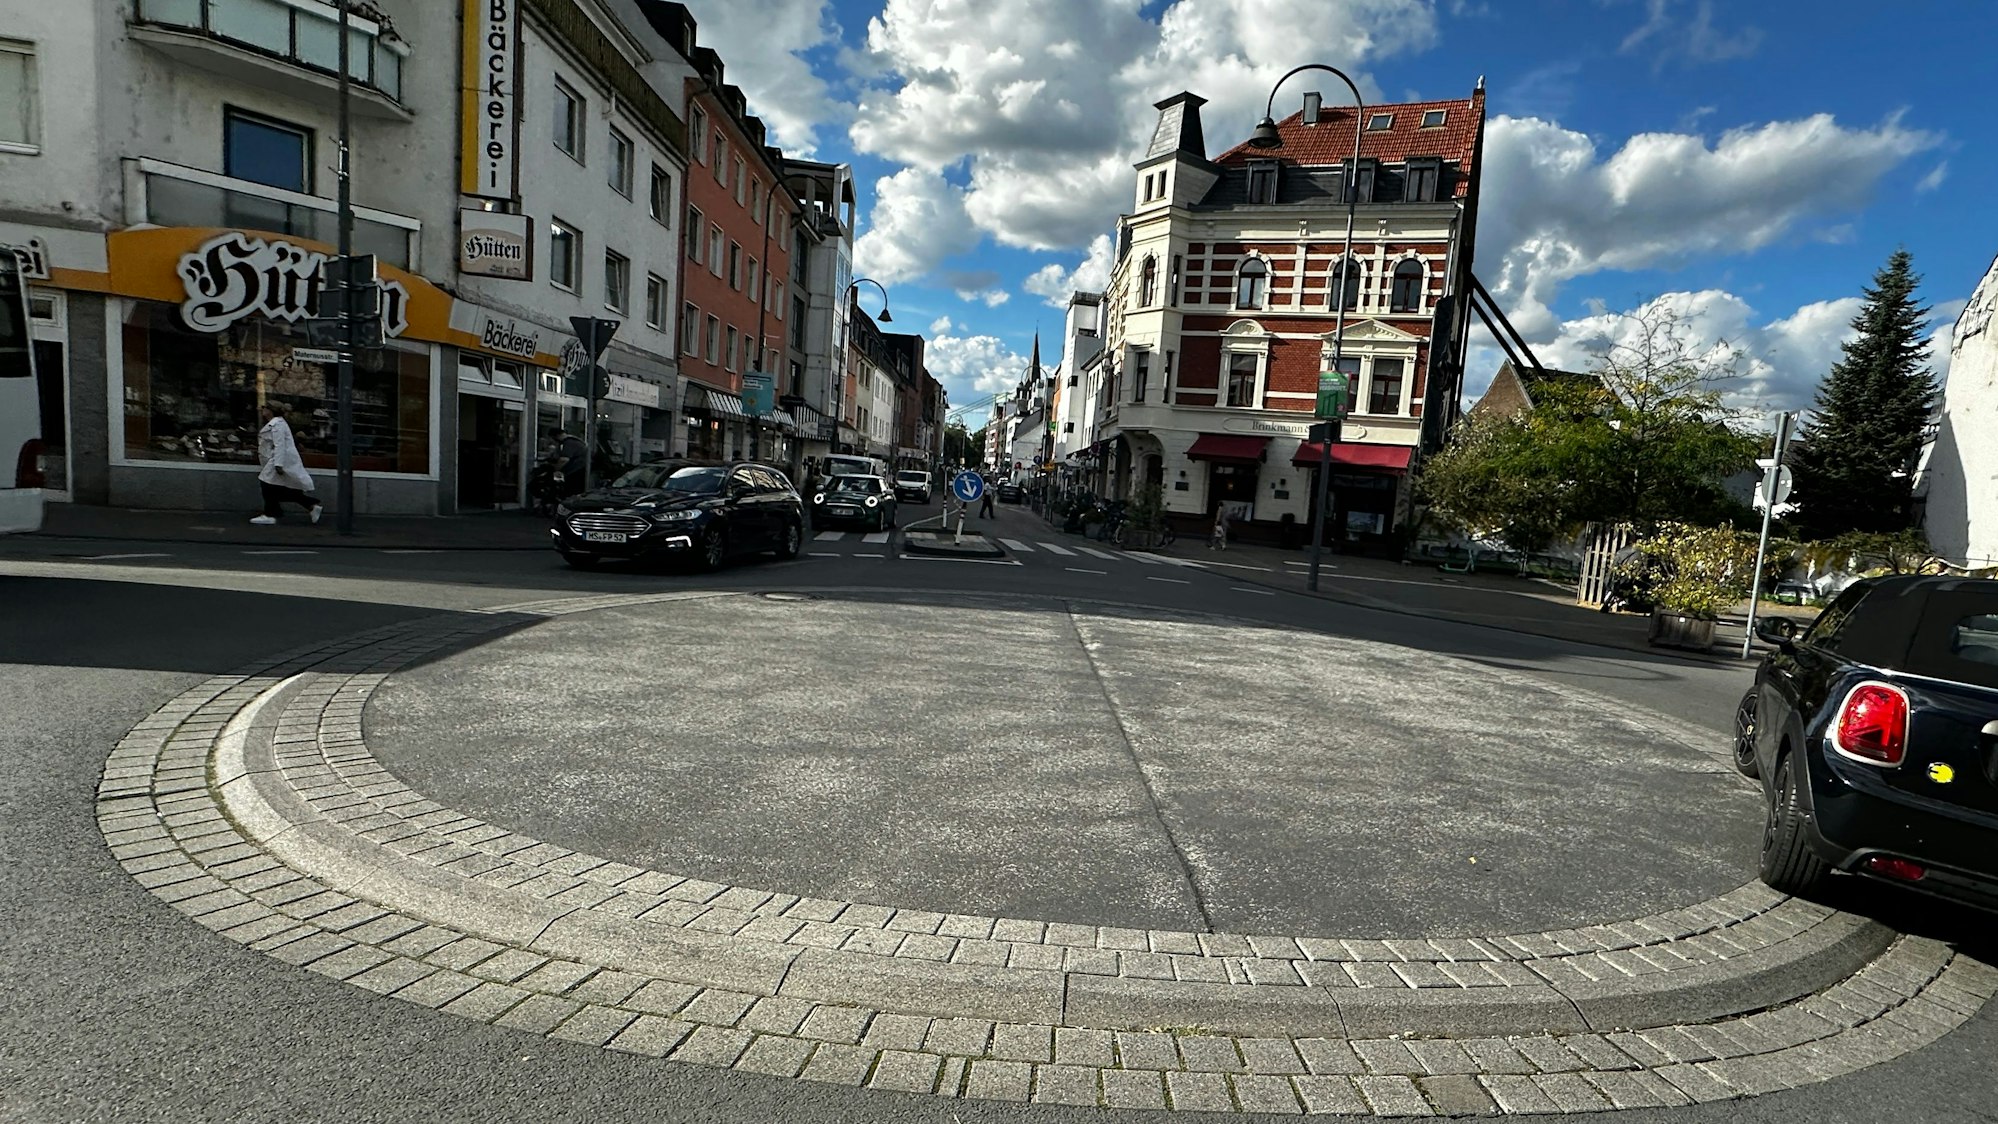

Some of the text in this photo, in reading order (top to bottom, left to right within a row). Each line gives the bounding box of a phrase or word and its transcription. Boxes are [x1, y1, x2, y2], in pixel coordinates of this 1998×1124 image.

[486, 0, 507, 188] Bäckerei
[465, 235, 521, 260] Hütten
[186, 239, 402, 330] Hütn
[483, 319, 539, 355] Bäckerei
[1252, 421, 1303, 434] Brinkmann
